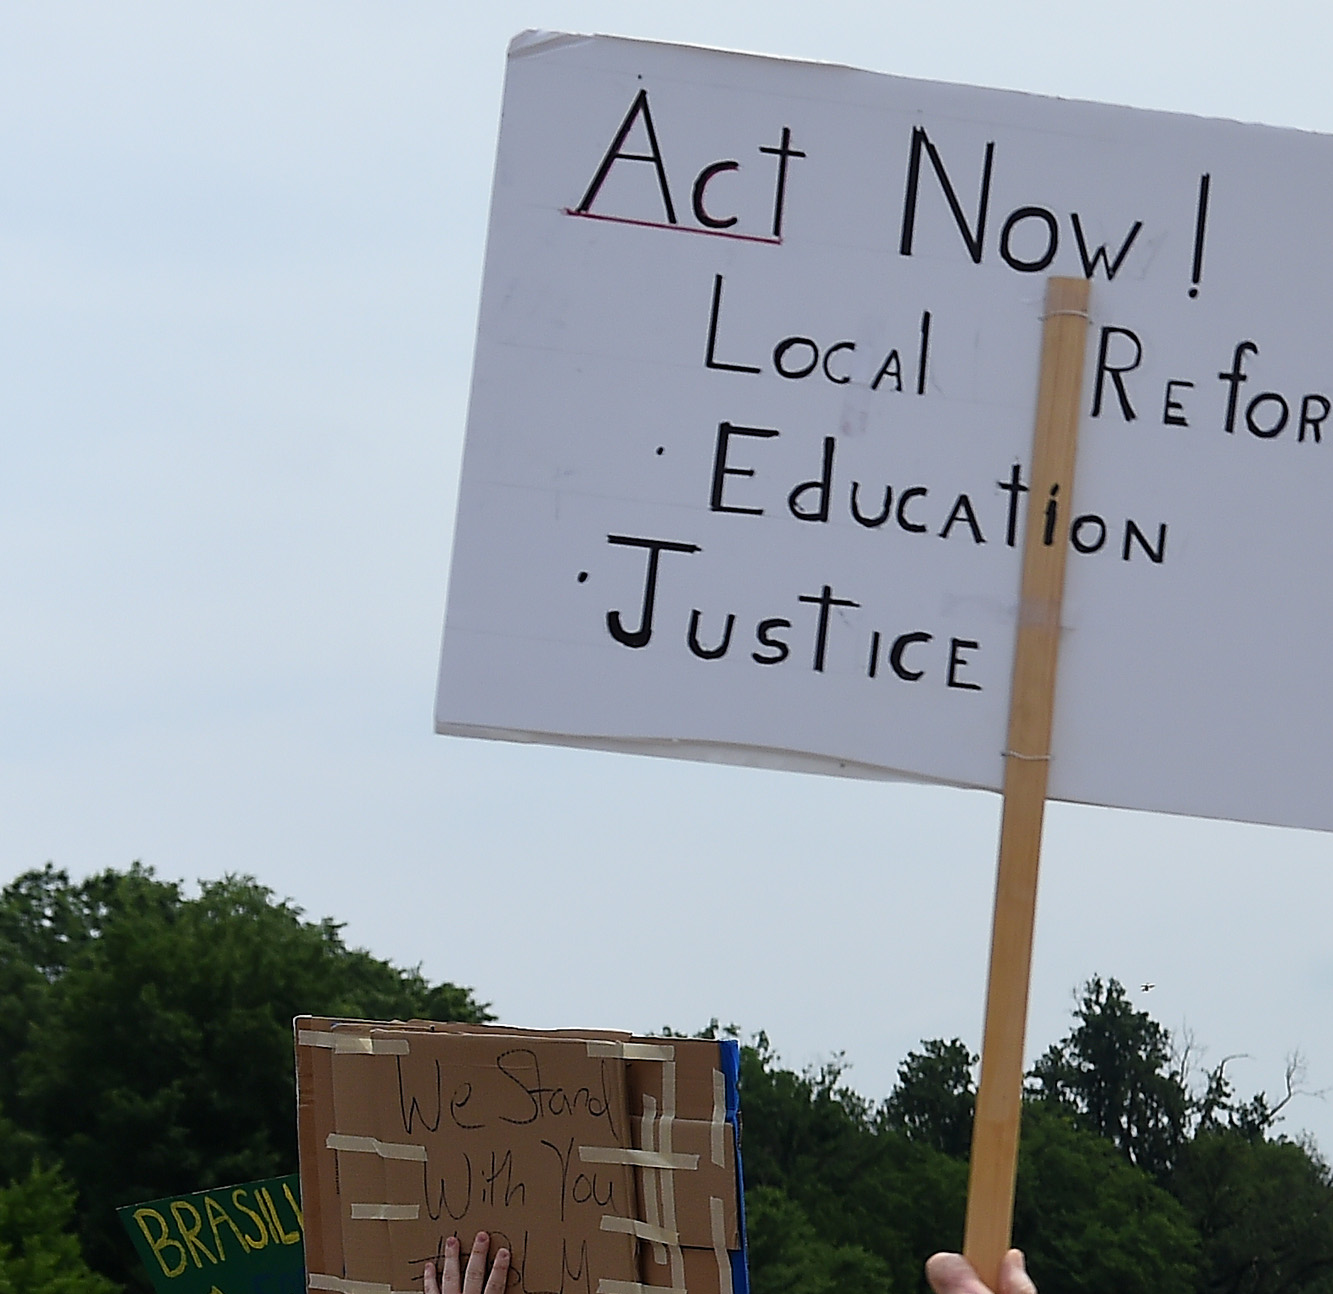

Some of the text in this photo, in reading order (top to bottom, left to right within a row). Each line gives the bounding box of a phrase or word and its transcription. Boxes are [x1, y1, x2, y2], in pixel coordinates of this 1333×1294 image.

[576, 88, 807, 240] Act
[396, 1048, 620, 1142] We Stand
[423, 1150, 526, 1221] With
[540, 1136, 618, 1223] You
[133, 1183, 304, 1278] BRASIL
